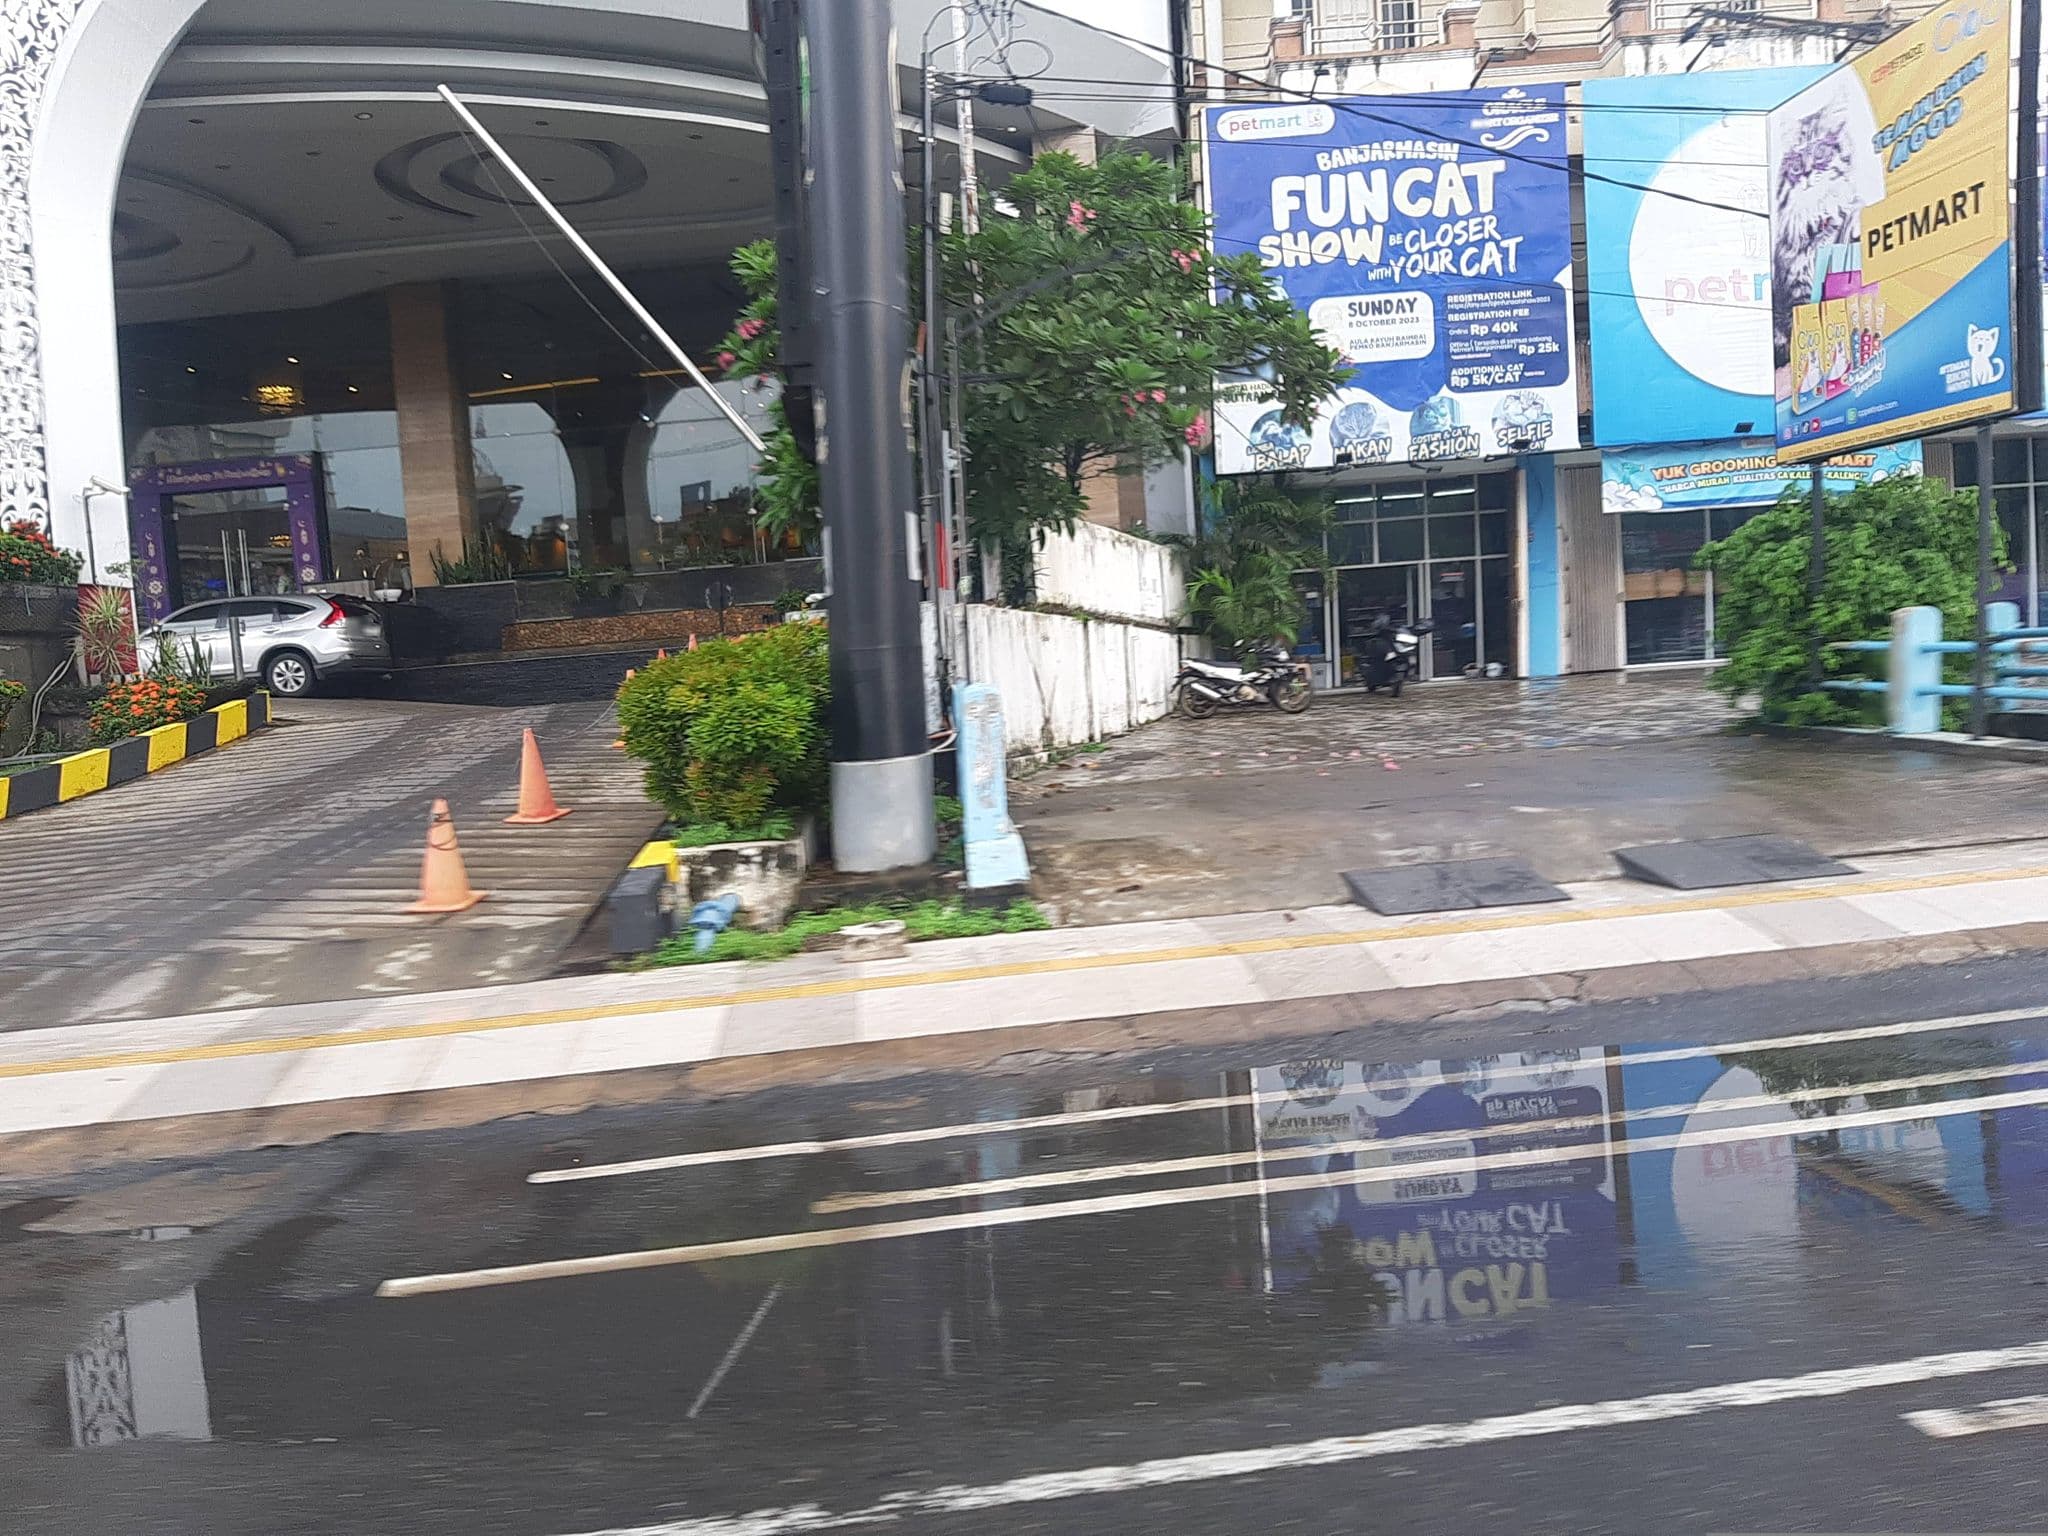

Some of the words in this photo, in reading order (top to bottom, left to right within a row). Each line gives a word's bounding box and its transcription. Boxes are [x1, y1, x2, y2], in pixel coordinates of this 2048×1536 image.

[1229, 115, 1302, 135] petmart
[1316, 140, 1460, 171] BANJARMASIN
[1271, 168, 1389, 231] FUN
[1392, 160, 1507, 218] CAT
[1867, 181, 1985, 258] PETMART
[1258, 224, 1384, 268] SHOW
[1388, 233, 1403, 246] BE
[1404, 214, 1502, 254] CLOSER
[1368, 268, 1392, 281] WITH
[1389, 248, 1458, 284] YOUR
[1460, 236, 1524, 277] CAT
[1447, 291, 1511, 303] REGISTRATION
[1512, 289, 1533, 299] LINK
[1348, 297, 1418, 317] SUNDAY
[1447, 309, 1511, 322] REGISTRATION
[1512, 308, 1530, 317] FEE
[1355, 318, 1397, 328] OCTOBER
[1399, 316, 1420, 324] 2023
[1470, 323, 1489, 337] Rp
[1491, 321, 1519, 334] 40k
[1518, 344, 1536, 356] Rp
[1537, 341, 1560, 354] 25k
[1450, 375, 1470, 388] Rp
[1471, 370, 1522, 386] 5k/CAT
[1451, 364, 1506, 376] ADDITIONAL
[1506, 363, 1525, 371] CAT
[1497, 420, 1552, 447] SELFIE
[1408, 433, 1480, 460] FASHION
[1652, 466, 1686, 481] YUK
[1689, 455, 1777, 475] GROOMING
[1697, 476, 1730, 488] MURAH
[1733, 471, 1776, 484] KUALITAS
